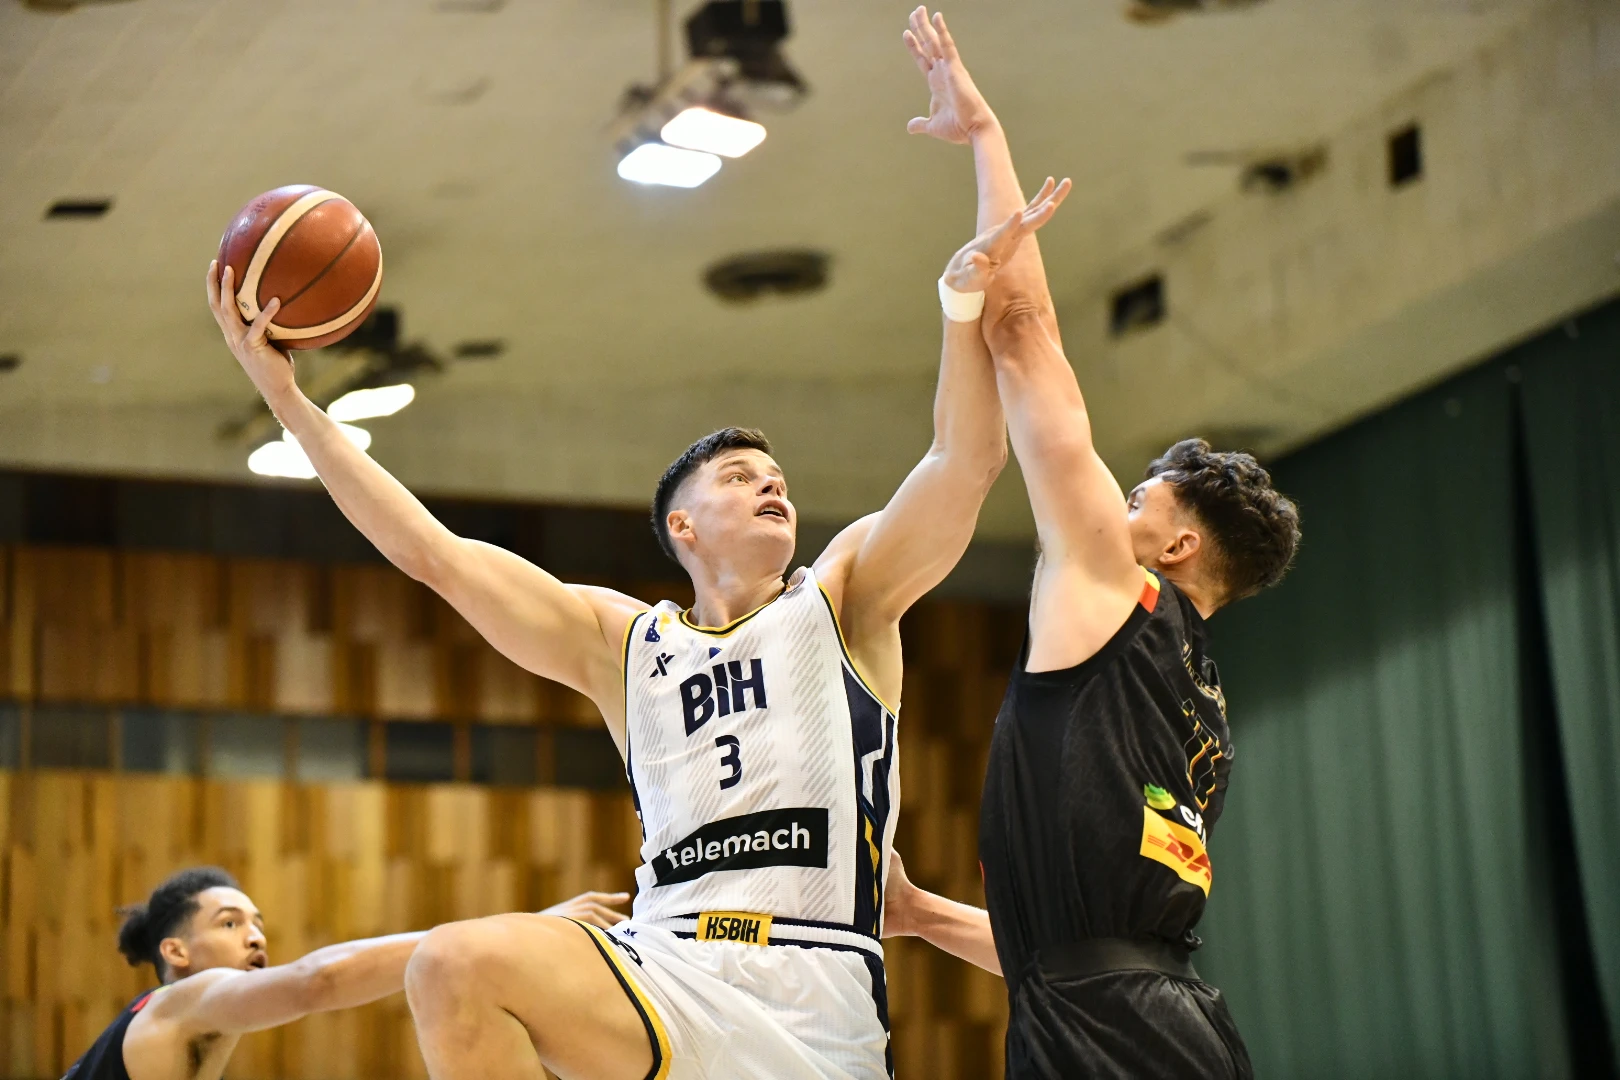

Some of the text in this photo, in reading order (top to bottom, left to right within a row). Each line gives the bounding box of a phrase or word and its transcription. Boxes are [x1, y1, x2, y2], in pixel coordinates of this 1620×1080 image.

[679, 658, 768, 737] BIH
[715, 735, 742, 790] 3
[666, 822, 810, 870] telemach
[705, 916, 761, 943] KSBIH
